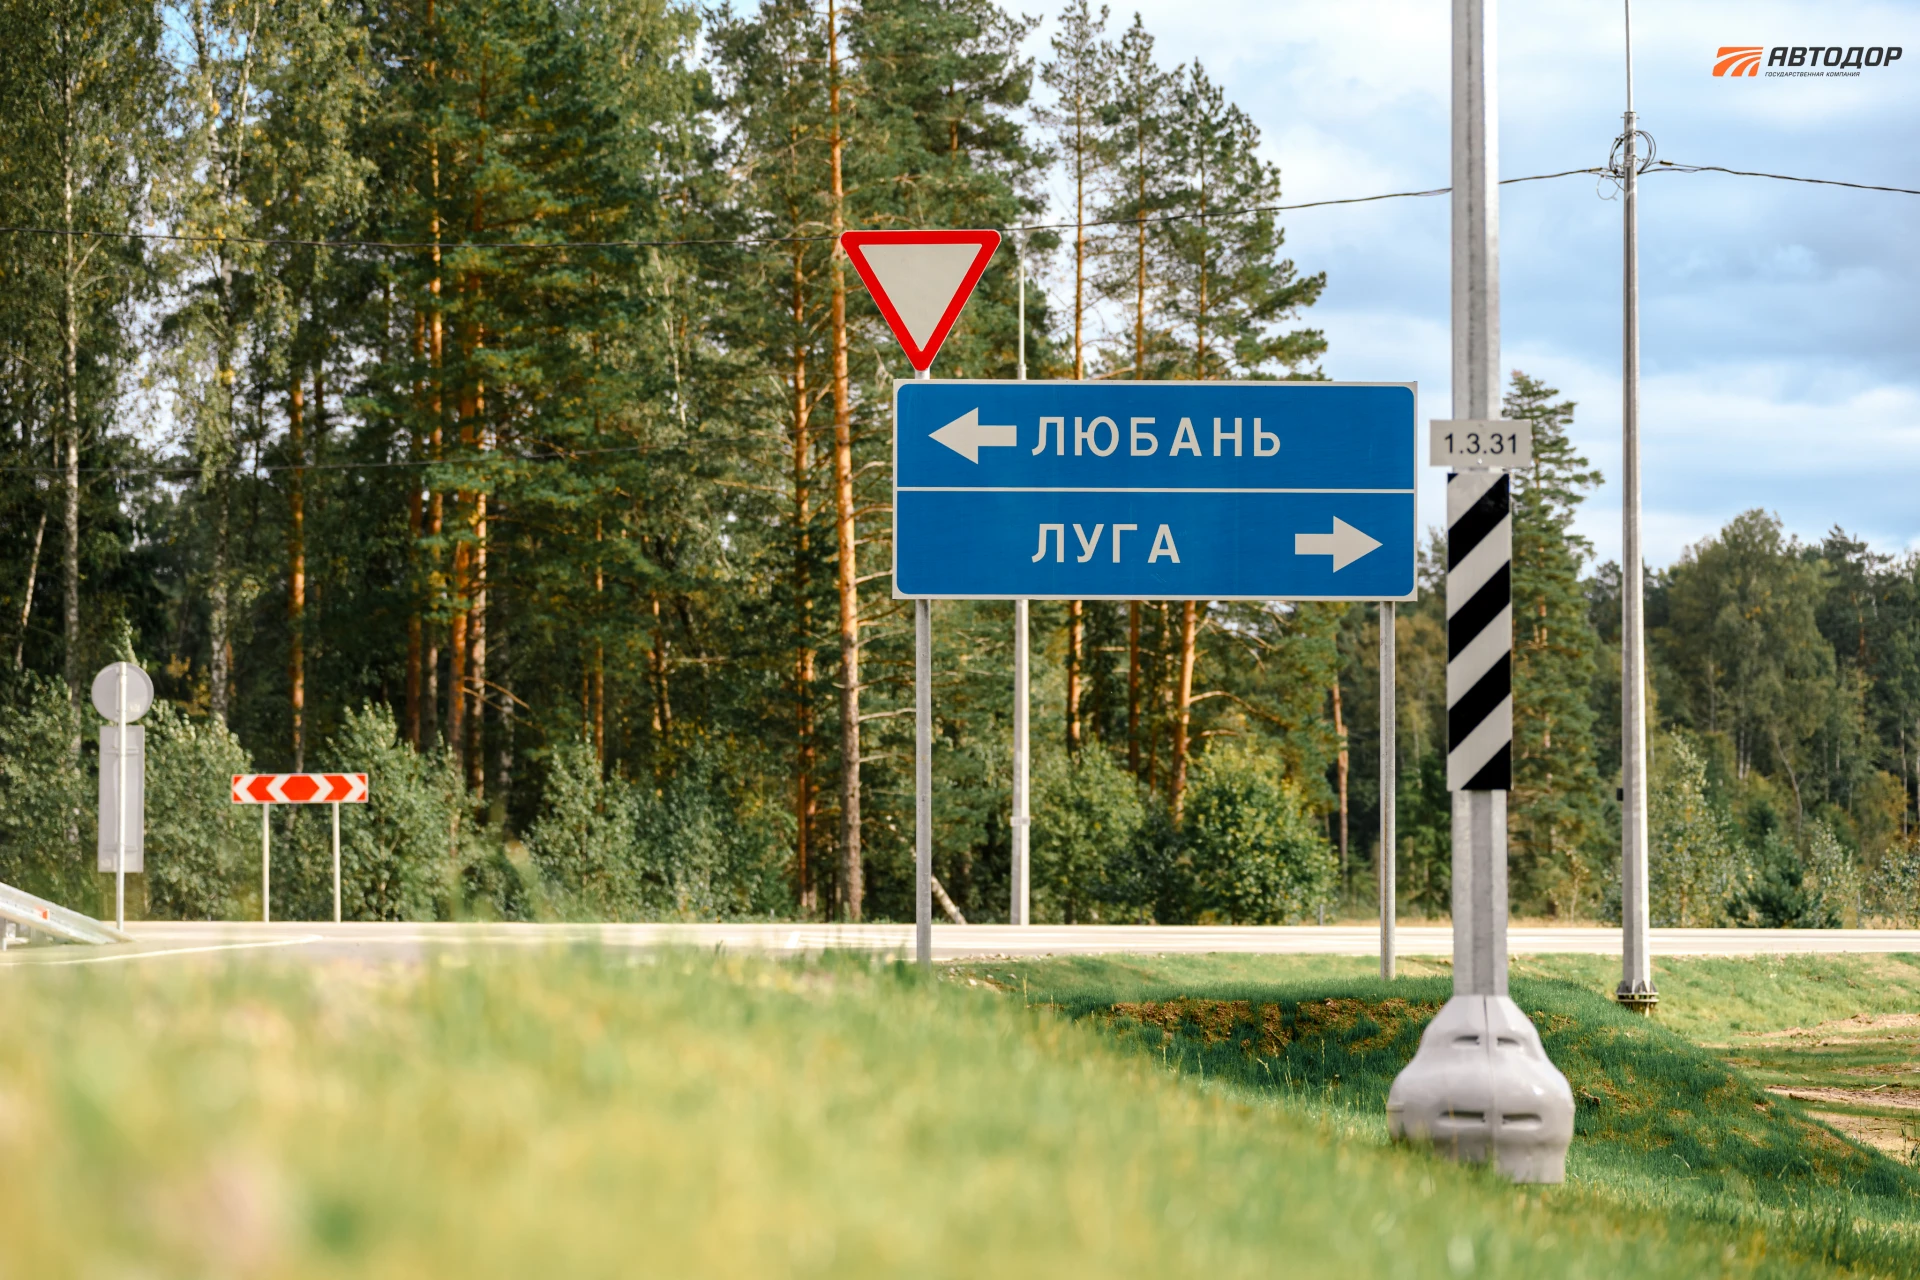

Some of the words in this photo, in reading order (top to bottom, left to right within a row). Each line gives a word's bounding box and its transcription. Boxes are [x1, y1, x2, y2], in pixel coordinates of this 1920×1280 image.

[1031, 415, 1281, 457] ЛЮБАНЬ
[1445, 433, 1516, 454] 1.3.31
[1031, 523, 1181, 564] ЛУГА
